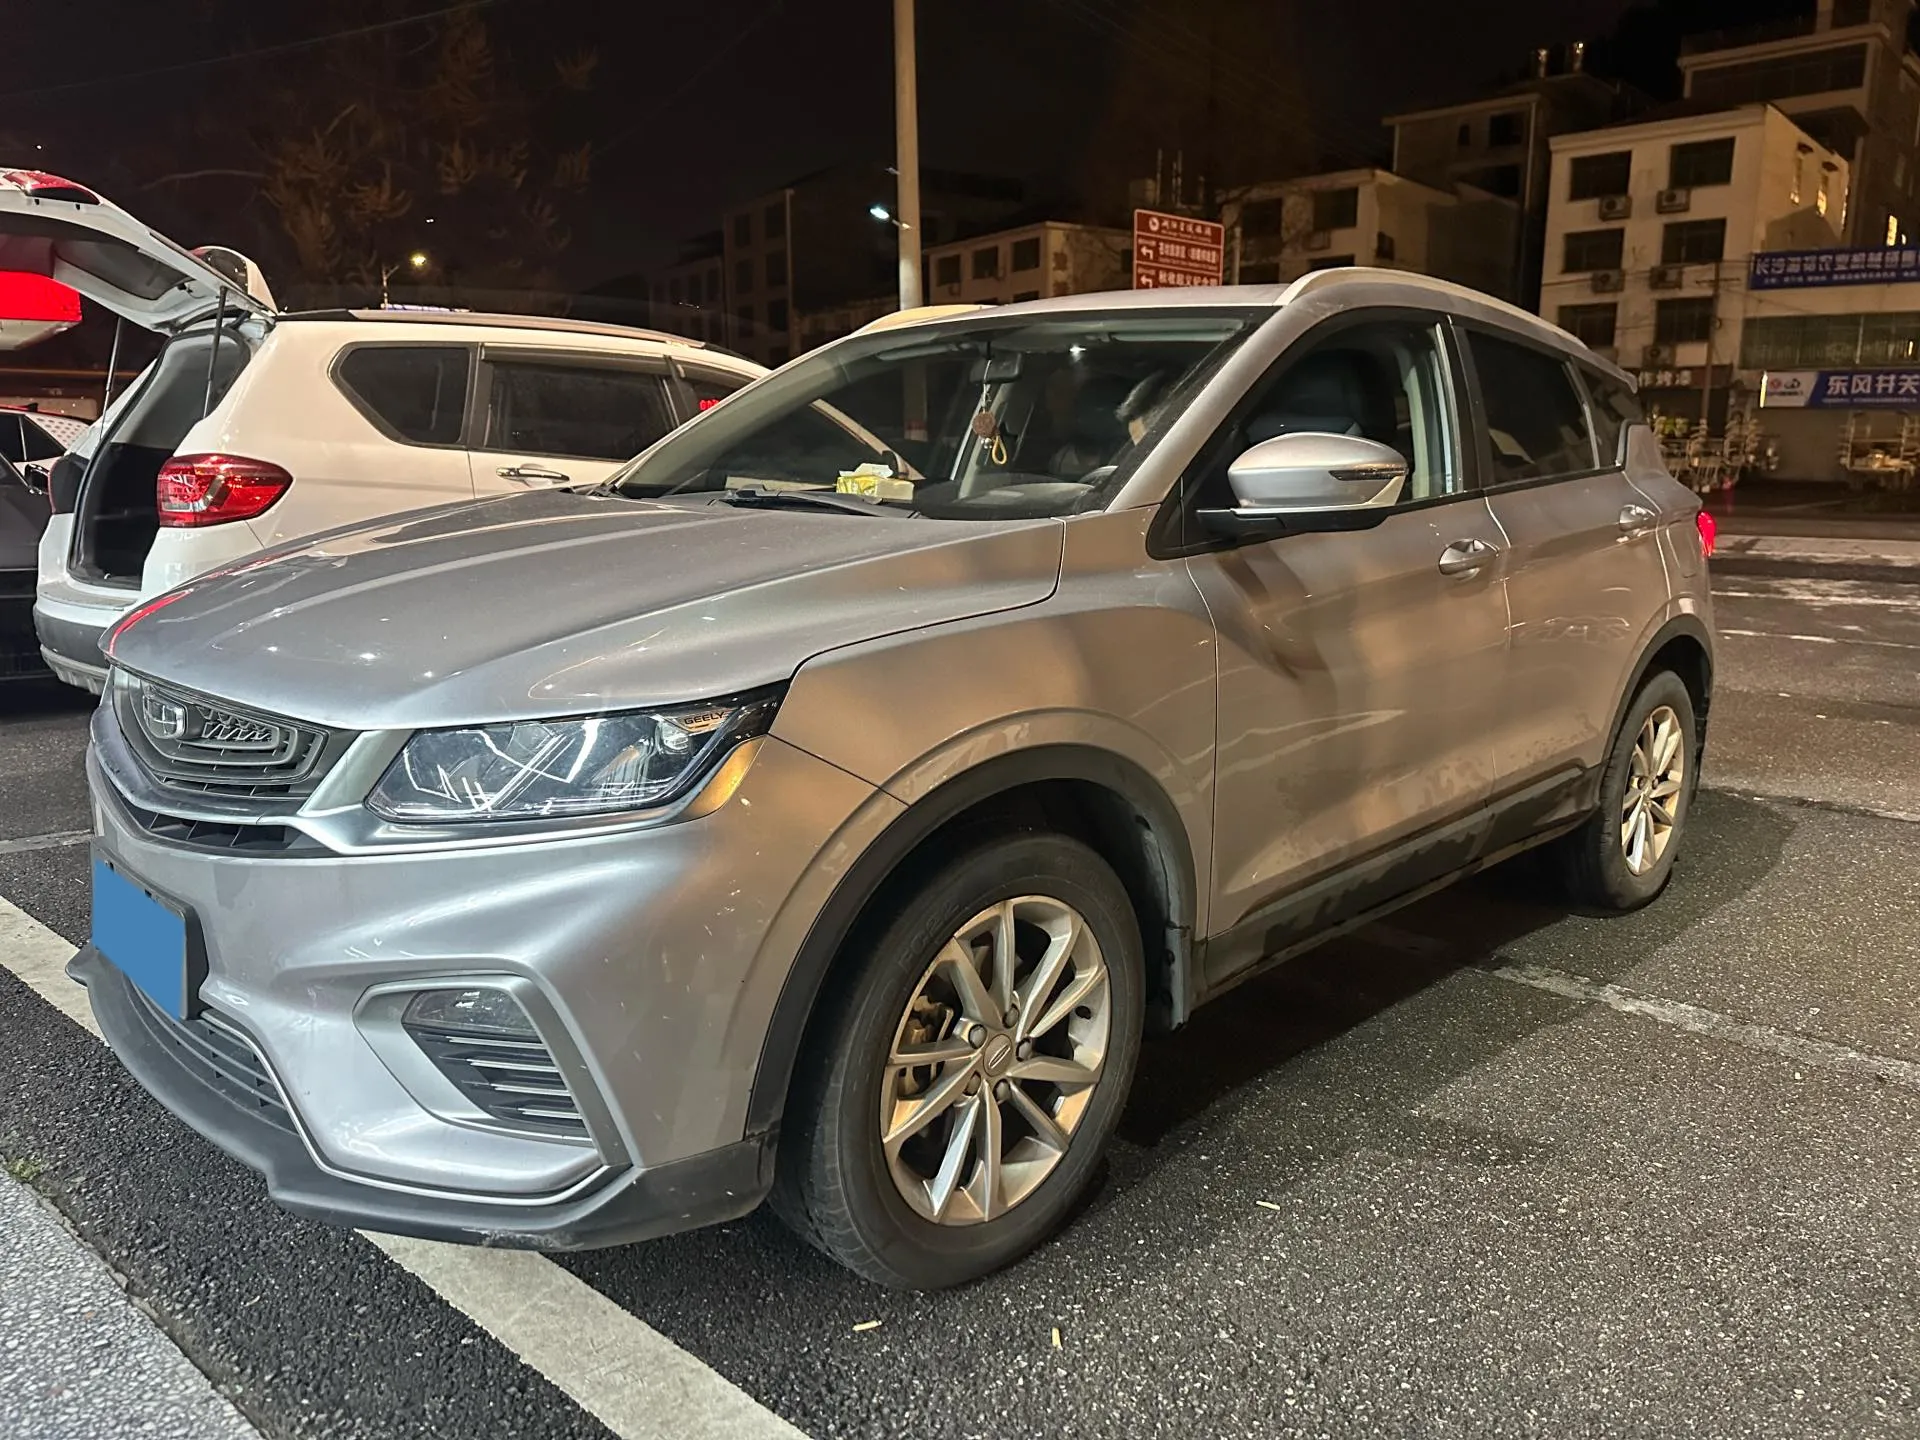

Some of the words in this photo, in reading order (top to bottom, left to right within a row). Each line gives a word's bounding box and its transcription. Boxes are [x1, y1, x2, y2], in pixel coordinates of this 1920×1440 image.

[1827, 374, 1920, 395] 东风井关
[684, 711, 725, 724] GEELY
